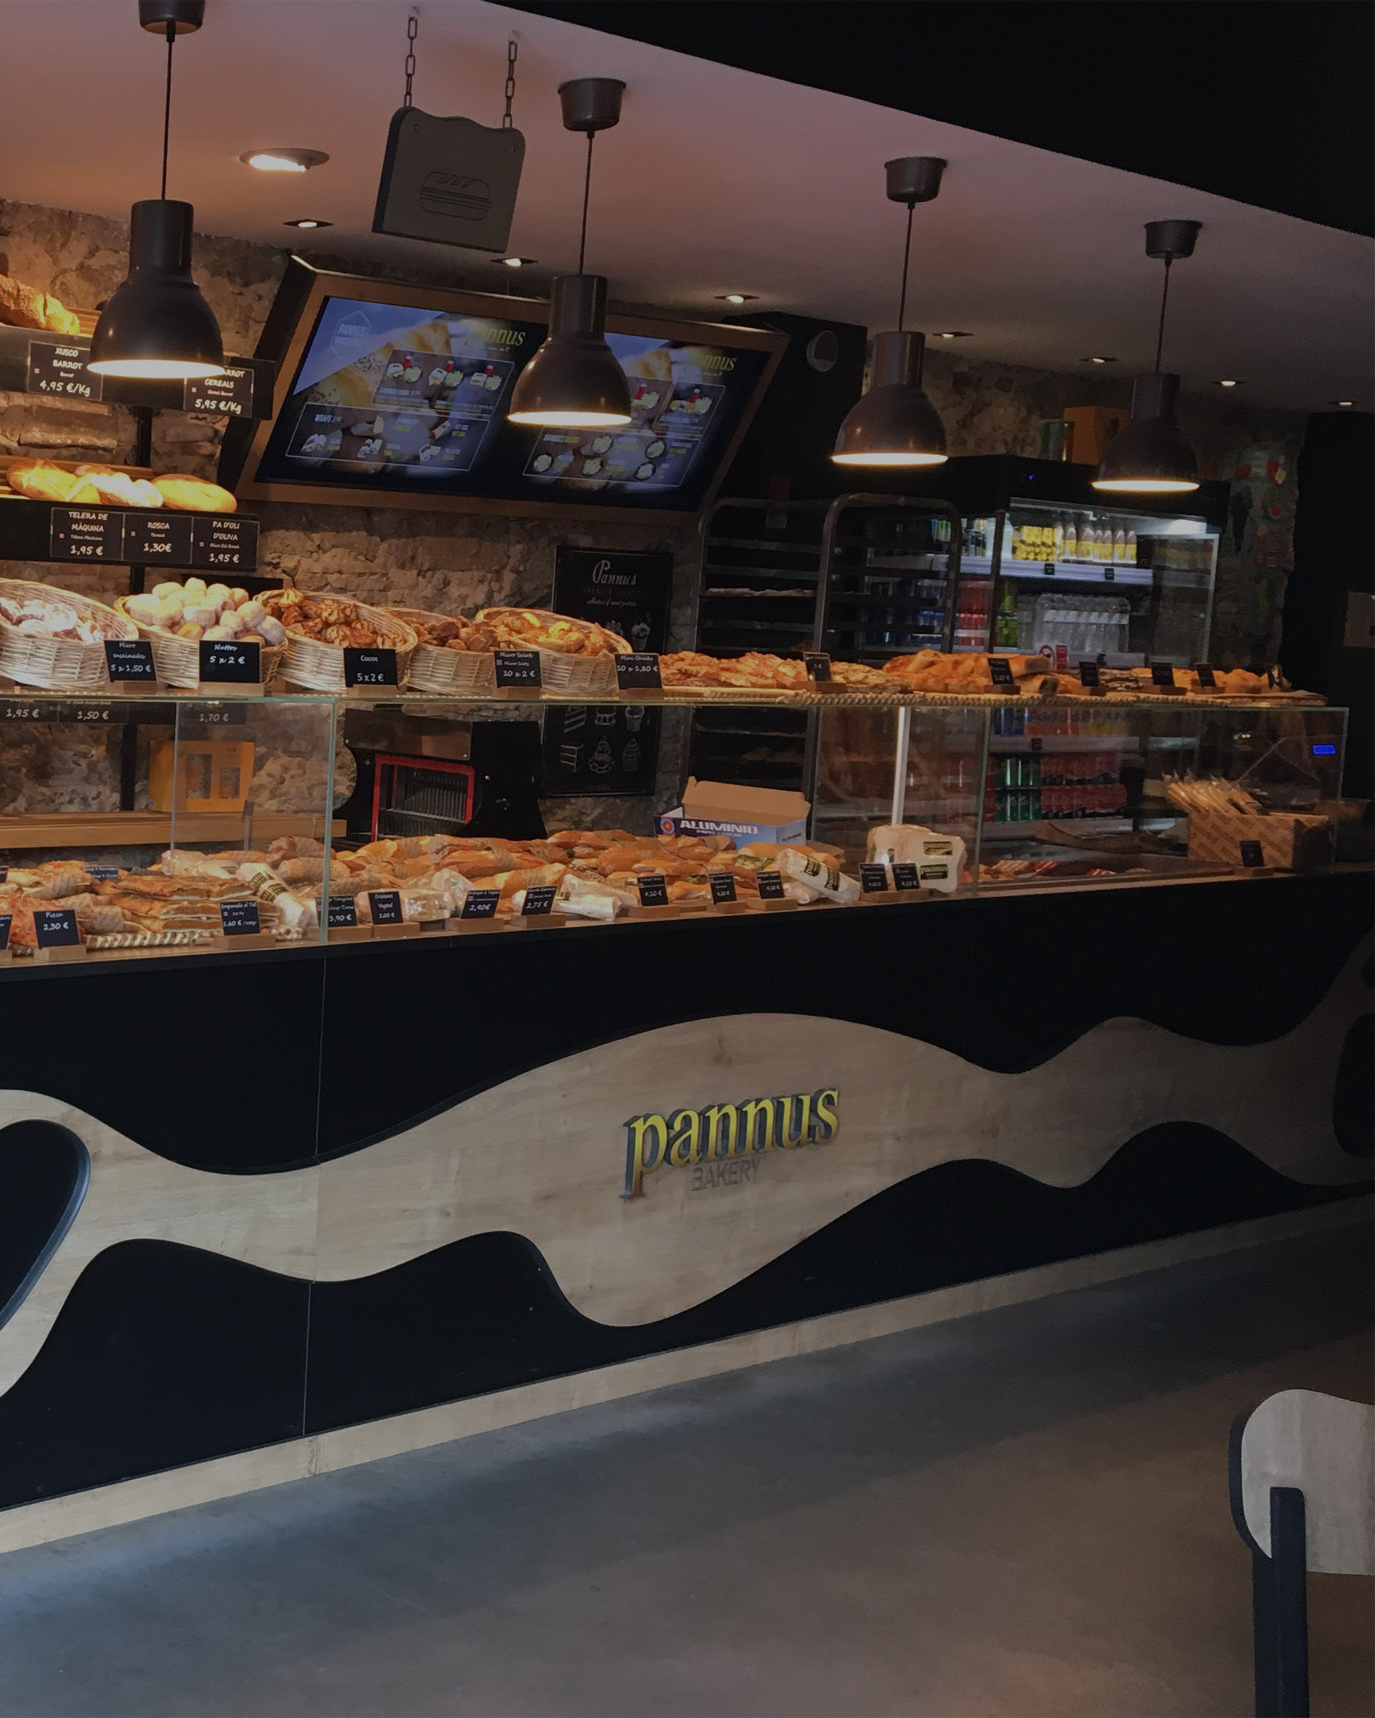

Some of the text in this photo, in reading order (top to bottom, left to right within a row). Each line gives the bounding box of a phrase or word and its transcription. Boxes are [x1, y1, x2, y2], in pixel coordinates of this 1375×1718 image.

[39, 380, 64, 391] 4,95
[204, 378, 235, 389] CEREALS
[194, 398, 217, 410] 5,95
[68, 511, 108, 521] TELERA DE
[71, 523, 105, 533] MÀQUINA
[147, 521, 170, 530] ROSCA
[212, 521, 222, 529] PA
[69, 544, 104, 556] 1,95 €
[209, 553, 231, 563] 1,95
[592, 559, 637, 587] Pannus
[126, 664, 143, 673] 1,50
[6, 708, 29, 719] 1,95
[76, 711, 100, 720] 1,50
[198, 713, 220, 723] 1,70
[621, 1088, 839, 1199] pannus
[691, 1157, 764, 1191] BAKERY
